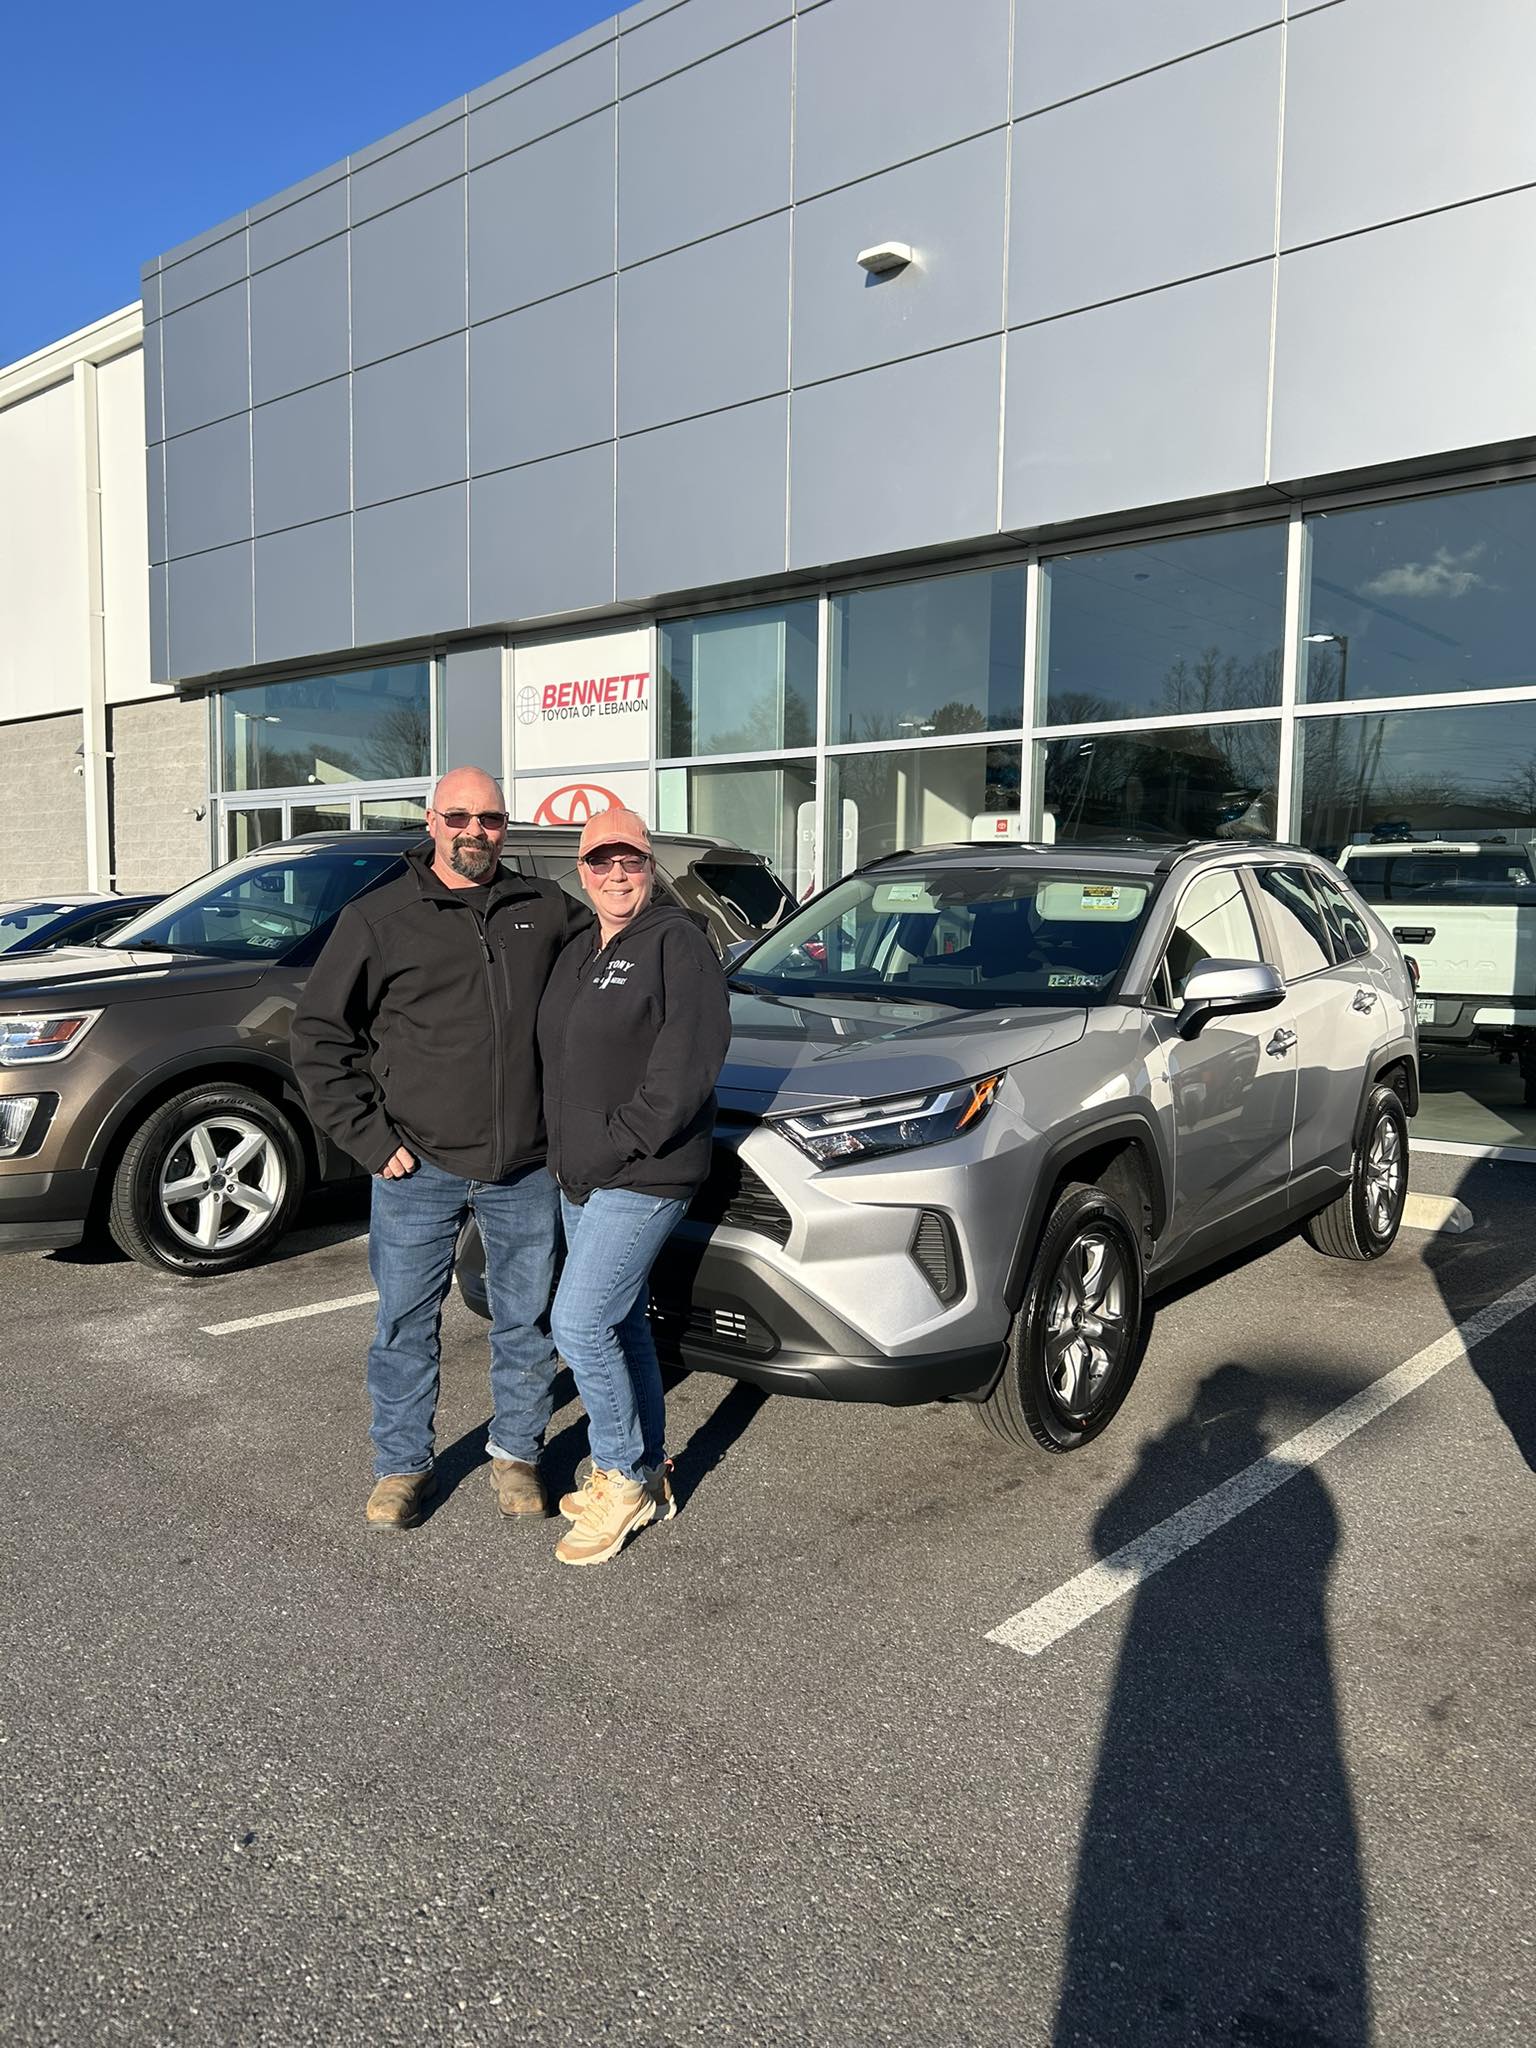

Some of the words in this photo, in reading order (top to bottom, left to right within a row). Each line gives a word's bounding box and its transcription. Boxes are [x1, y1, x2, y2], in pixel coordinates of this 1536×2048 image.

[542, 672, 650, 709] BENNETT
[542, 705, 580, 721] TOYOTA
[583, 704, 596, 717] OF
[599, 699, 648, 716] LEBANON
